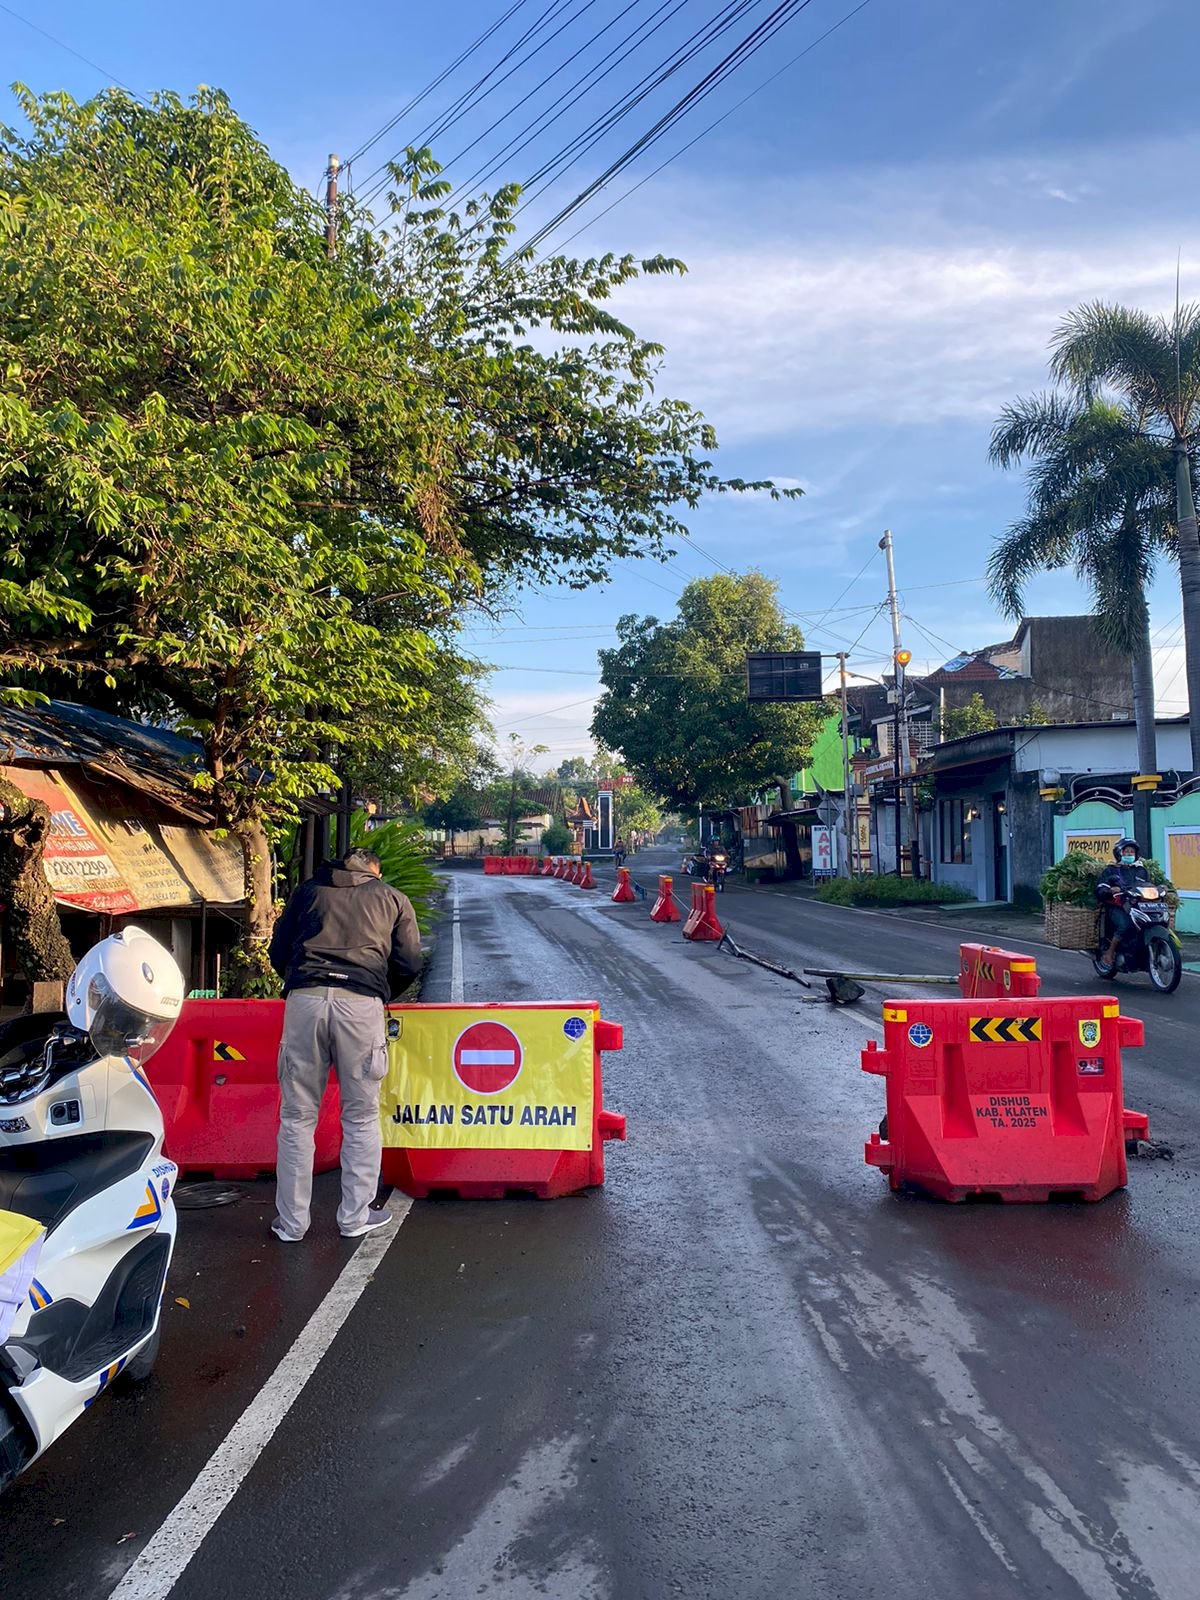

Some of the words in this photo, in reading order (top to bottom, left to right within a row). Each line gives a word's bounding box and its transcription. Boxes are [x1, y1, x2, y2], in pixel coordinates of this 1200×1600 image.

[818, 832, 831, 869] AKI
[77, 860, 108, 876] 2299
[990, 1097, 1030, 1106] DISHUB
[392, 1104, 454, 1125] JALAN
[460, 1105, 513, 1126] SATU
[520, 1106, 576, 1126] ARAH
[976, 1107, 1003, 1117] KAB.
[1005, 1107, 1047, 1117] KLATEN
[991, 1118, 1009, 1127] TA.
[1011, 1117, 1036, 1127] 2025
